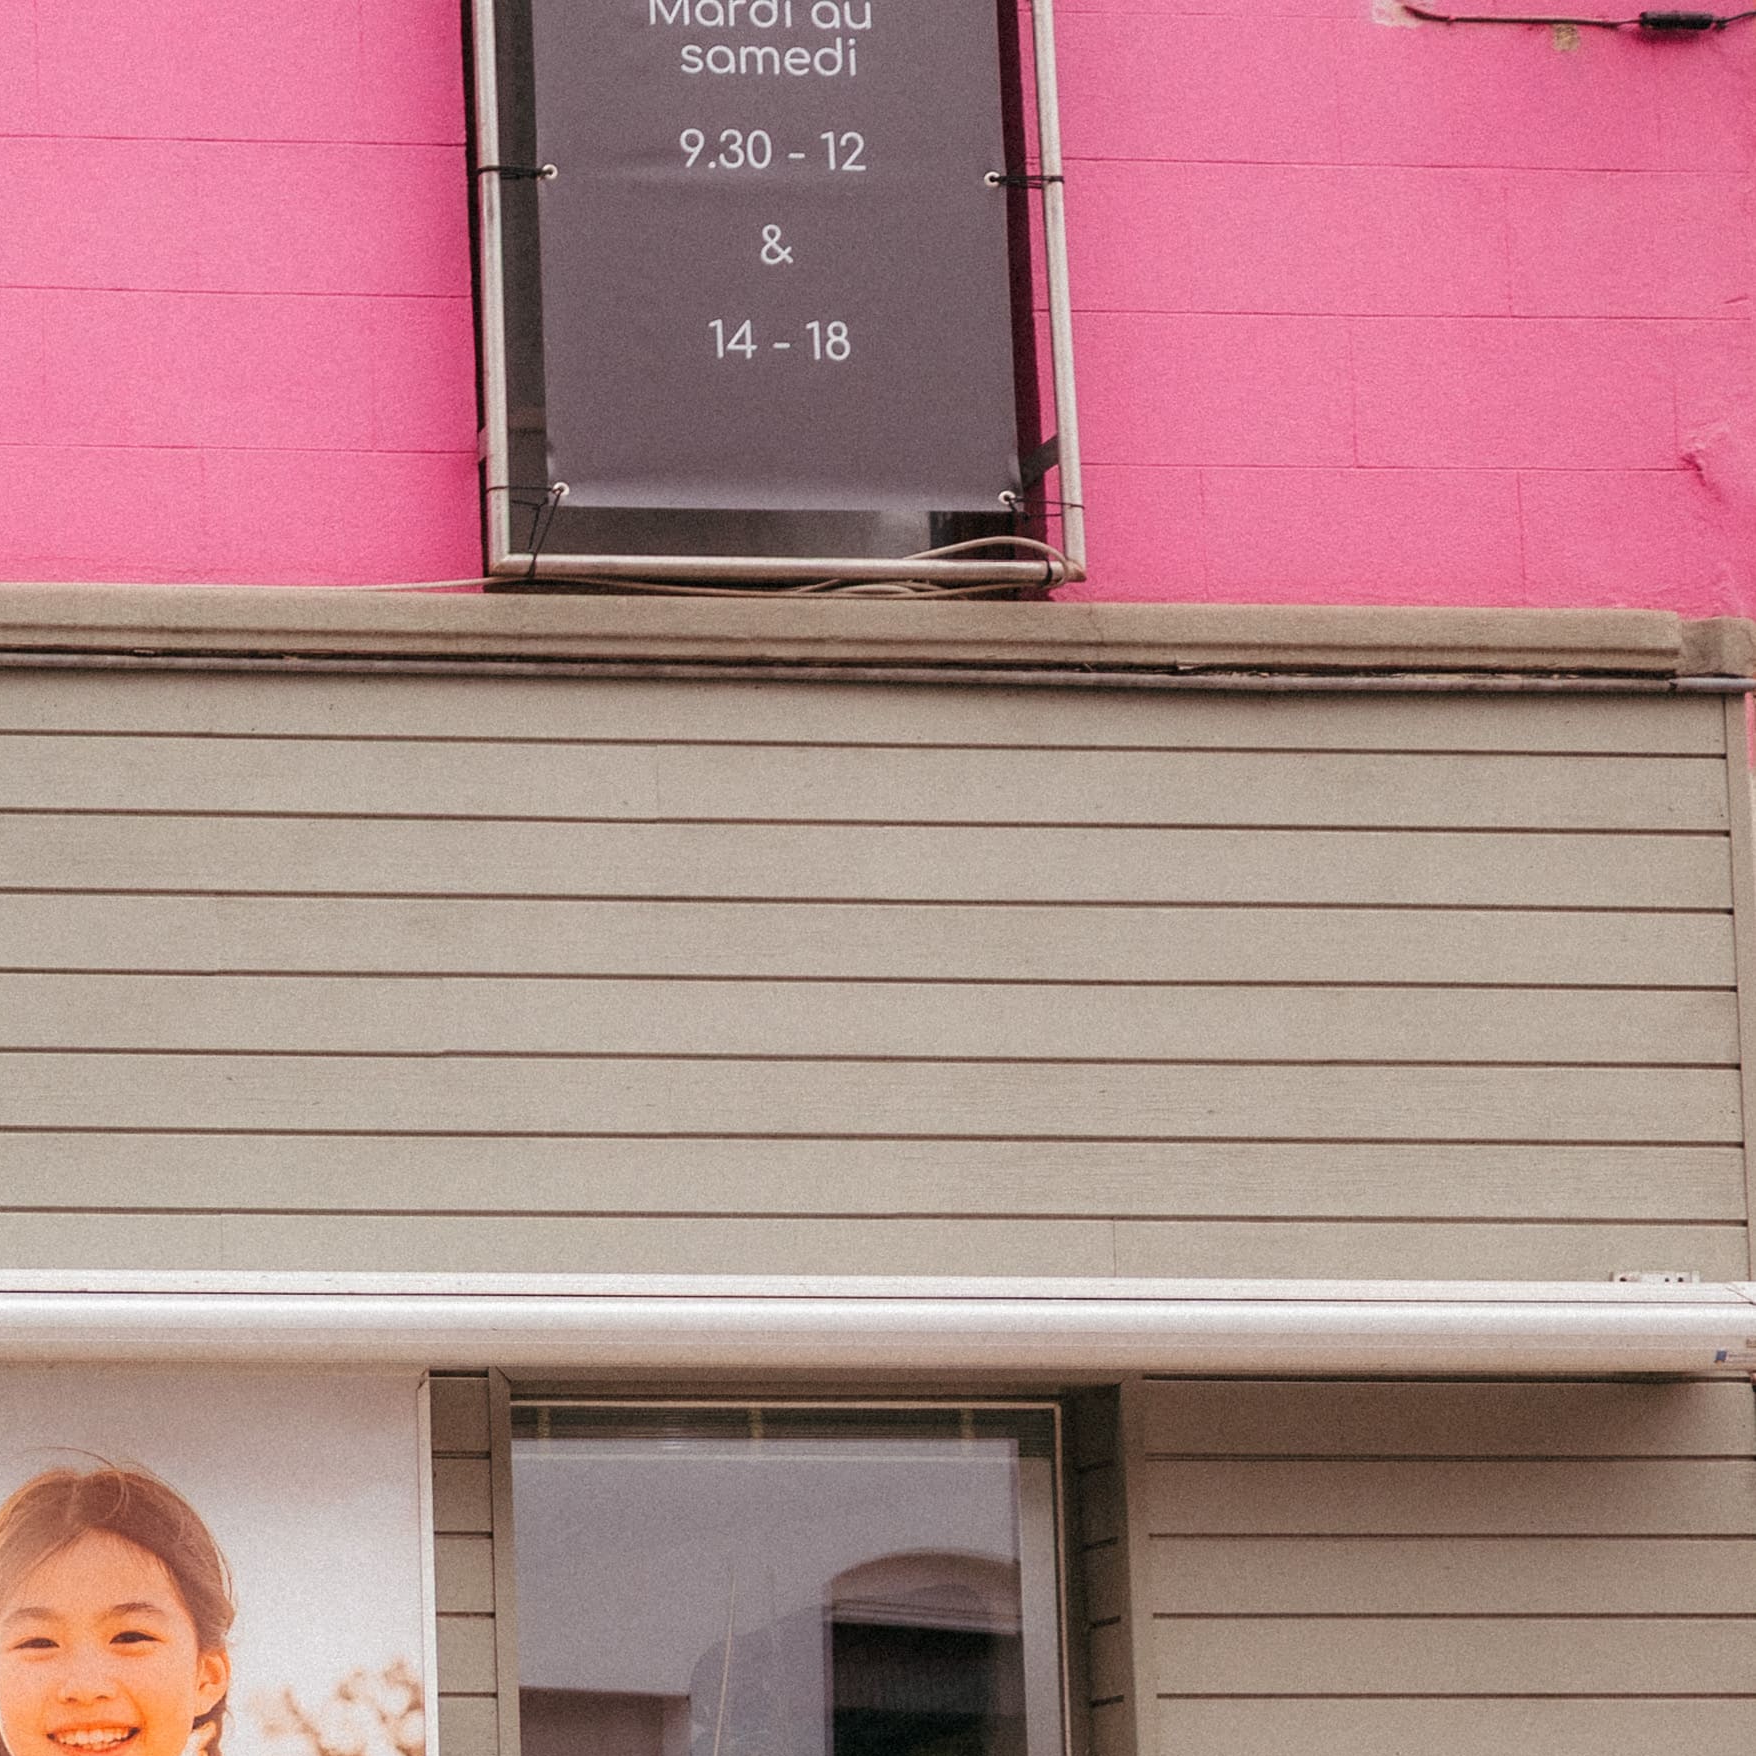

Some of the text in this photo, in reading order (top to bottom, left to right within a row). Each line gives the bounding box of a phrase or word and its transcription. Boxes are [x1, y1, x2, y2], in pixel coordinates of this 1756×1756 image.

[648, 0, 872, 30] Mardi au
[680, 36, 858, 77] samedi
[679, 128, 773, 170] 9.30
[820, 131, 867, 172] 12
[760, 223, 794, 266] &
[708, 319, 758, 360] 14
[805, 320, 851, 362] 18
